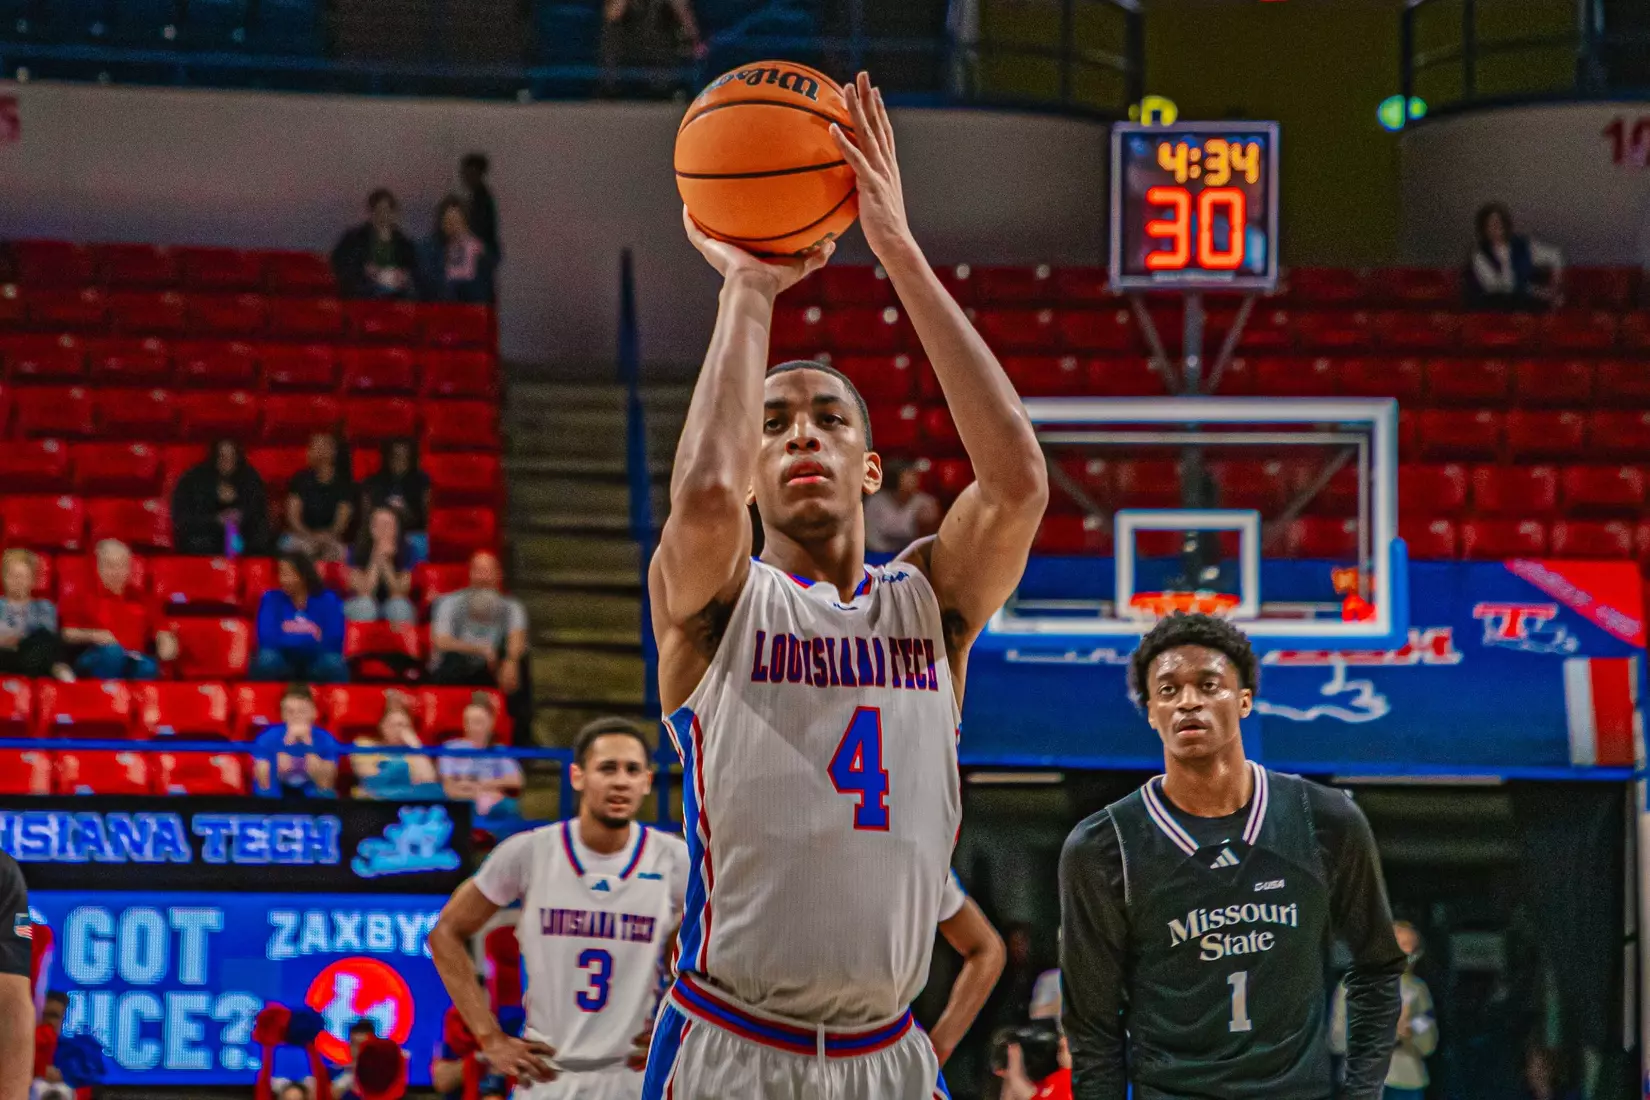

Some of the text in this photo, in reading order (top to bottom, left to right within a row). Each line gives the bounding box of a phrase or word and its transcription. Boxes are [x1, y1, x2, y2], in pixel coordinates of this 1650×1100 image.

[1157, 138, 1261, 187] 4:34
[1145, 186, 1247, 271] 30
[826, 705, 890, 833] 4
[191, 811, 342, 865] TECH
[62, 905, 226, 986] GOT
[1166, 902, 1298, 948] Missouri
[1199, 929, 1276, 961] State
[574, 947, 615, 1014] 3
[1226, 970, 1253, 1033] 1
